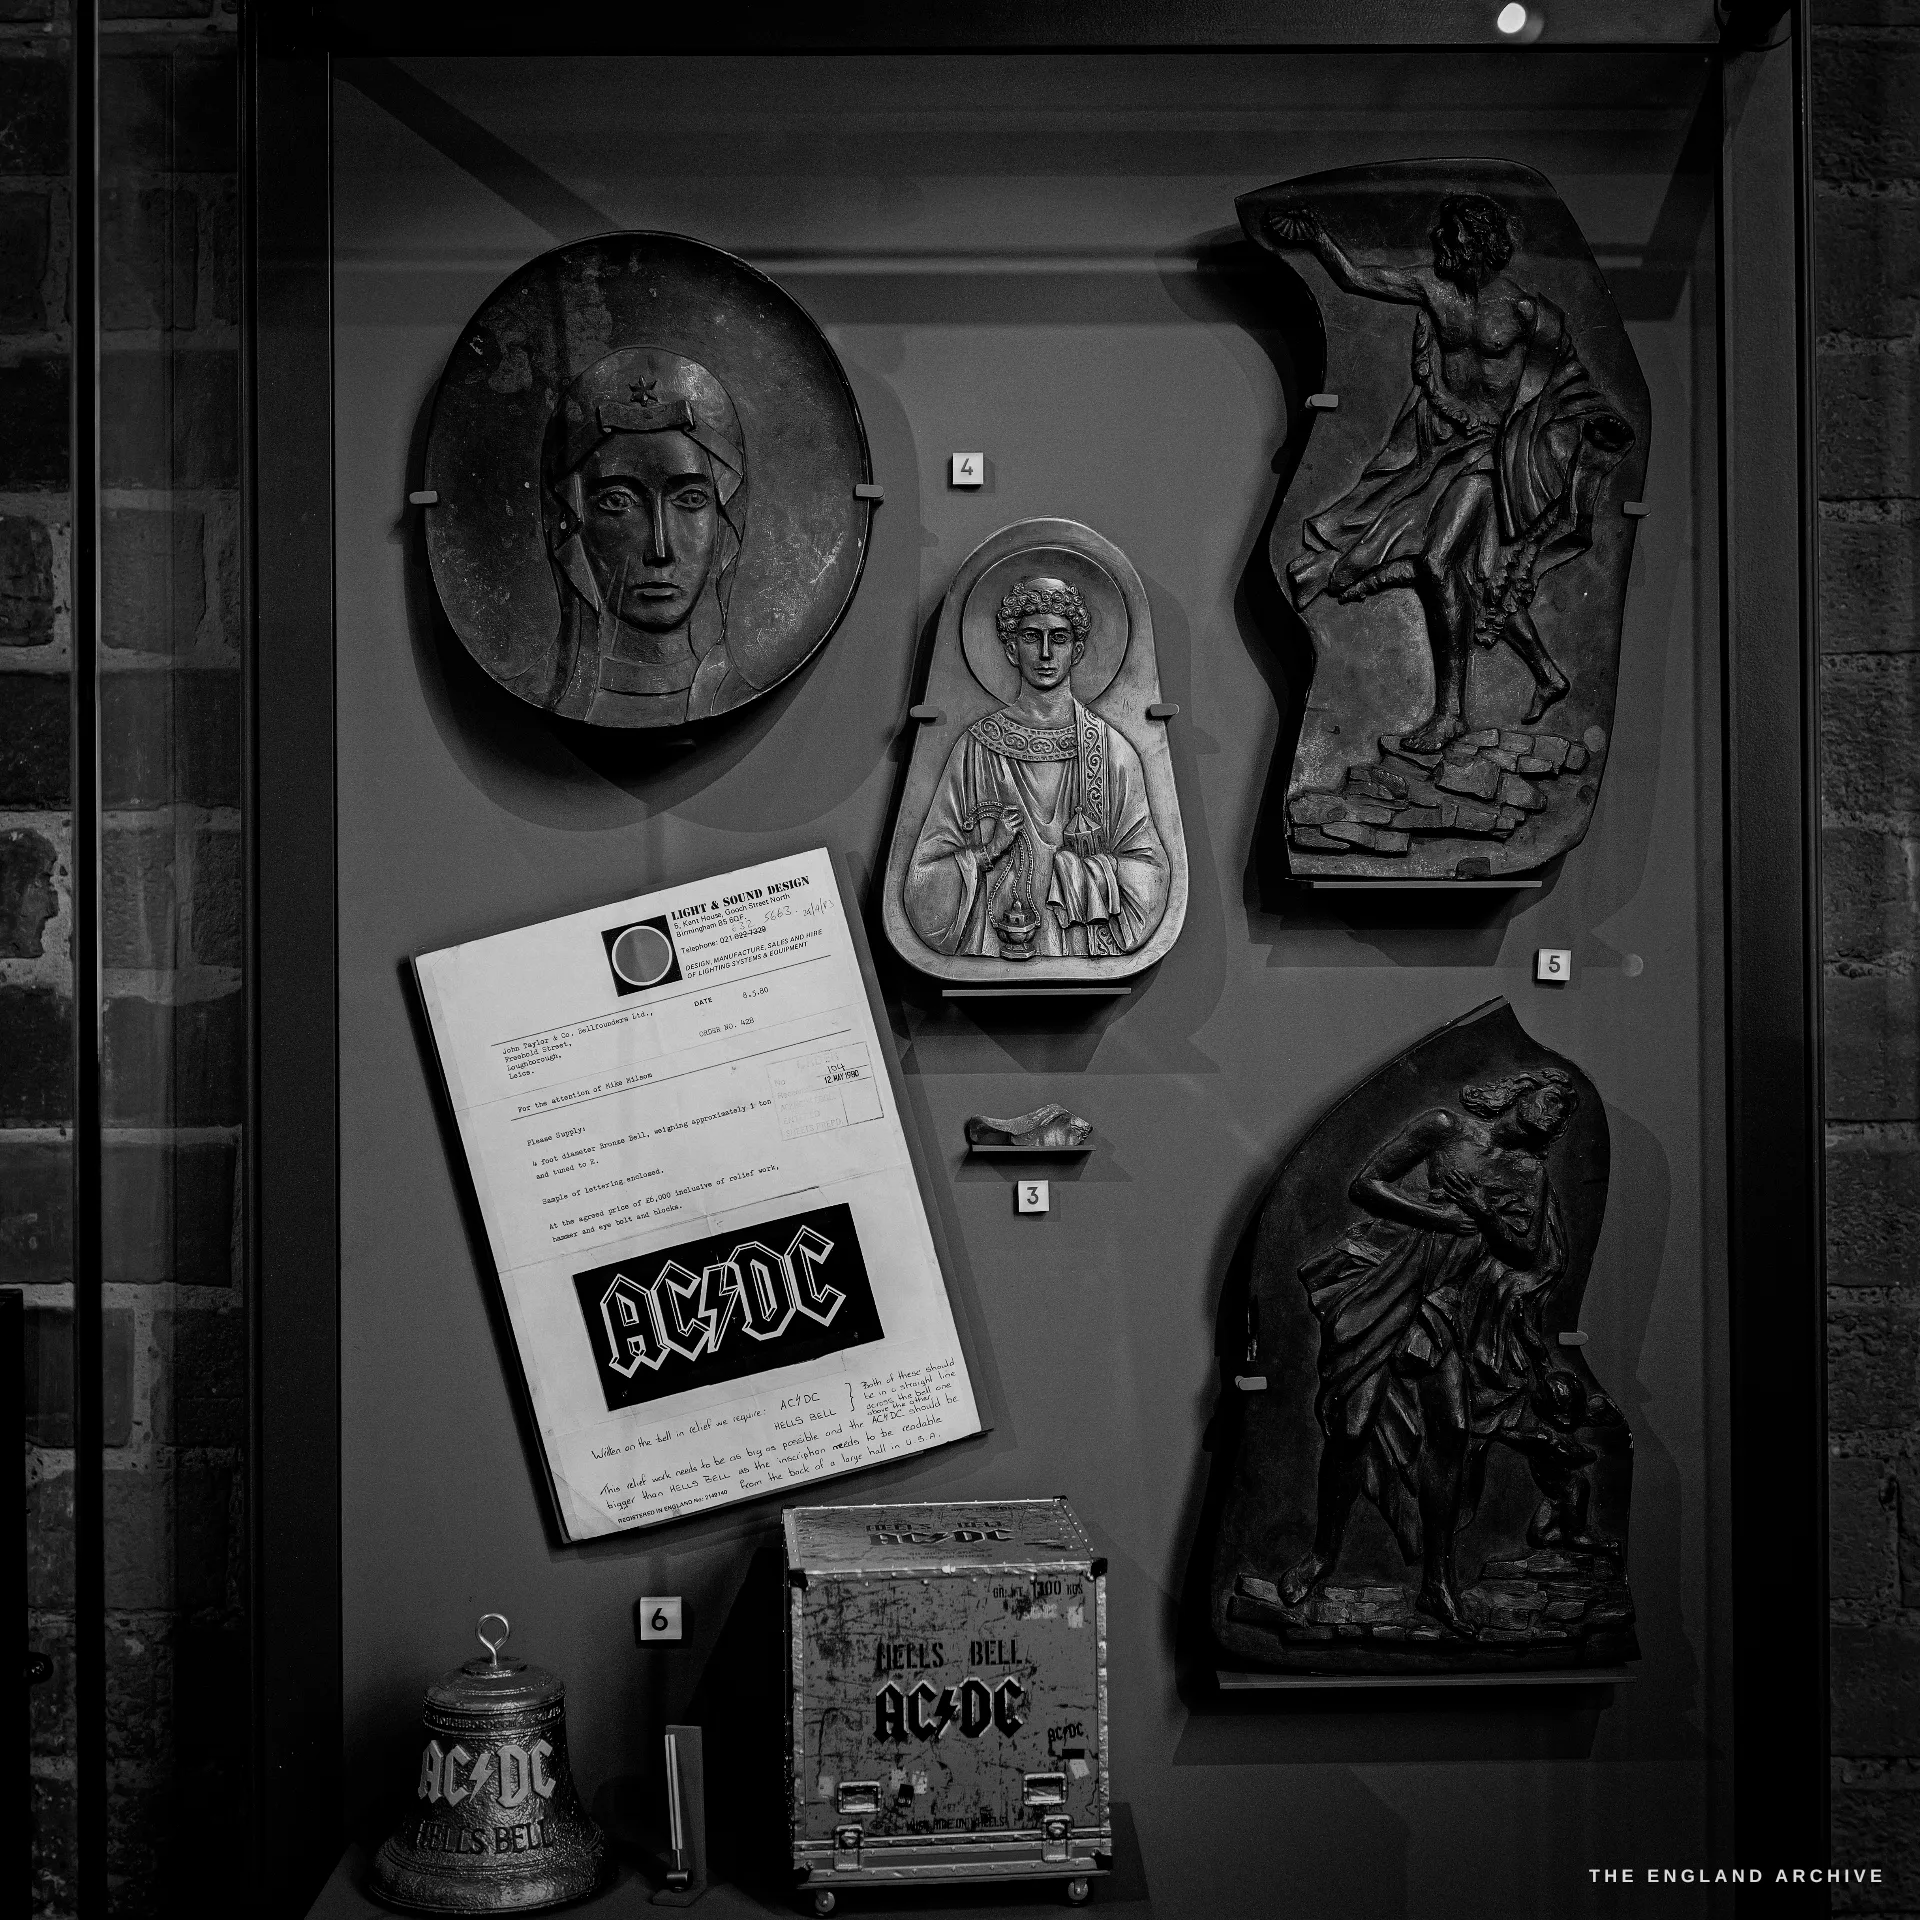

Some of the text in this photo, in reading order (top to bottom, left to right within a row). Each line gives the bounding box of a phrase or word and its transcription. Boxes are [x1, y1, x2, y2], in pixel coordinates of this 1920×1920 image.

[960, 458, 974, 476] 4
[671, 876, 809, 921] LIGHT & SOUND DESIGN
[683, 893, 790, 927] Kent House, Gooch Street North
[676, 923, 717, 937] Birmingham
[680, 941, 718, 954] Telephone:
[686, 929, 822, 971] DESIGN, MANUFACTURE, SALES AND HIRE
[699, 962, 730, 976] LIGHTING
[732, 954, 761, 966] SYSTEMS
[770, 941, 808, 956] EQUIPMENT
[1548, 956, 1560, 972] 5
[694, 997, 712, 1007] DATE
[523, 1039, 549, 1049] Taylor
[699, 1027, 721, 1037] ORDER
[505, 1041, 571, 1063] Freehold Street,
[552, 1090, 590, 1103] attention
[605, 1081, 622, 1089] Mike
[527, 1127, 585, 1146] Please Supply:
[541, 1156, 558, 1165] foot
[562, 1147, 595, 1159] diameter
[599, 1139, 625, 1149] Bronze
[628, 1132, 649, 1141] Bell,
[654, 1122, 688, 1134] weighing
[692, 1104, 746, 1125] approximately
[536, 1171, 549, 1179] and
[553, 1165, 574, 1175] tuned
[542, 1194, 568, 1204] Sample
[584, 1180, 624, 1193] lettering
[627, 1168, 663, 1182] enclosed.
[579, 1210, 604, 1222] agreed
[608, 1205, 629, 1215] price
[675, 1183, 712, 1196] inclusive
[729, 1170, 754, 1181] relief
[758, 1165, 779, 1173] work,
[1027, 1188, 1038, 1205] 3
[552, 1232, 578, 1242] hammer
[582, 1226, 595, 1234] and
[615, 1217, 632, 1225] bolt
[653, 1205, 682, 1215] blocks.
[860, 1357, 954, 1389] Both of these should
[900, 1374, 932, 1390] straight
[938, 1370, 956, 1379] line
[867, 1398, 894, 1409] across
[897, 1393, 912, 1401] the
[914, 1385, 931, 1396] bell
[774, 1409, 837, 1430] HELLS BELL
[867, 1407, 888, 1415] above
[591, 1445, 621, 1459] Written
[638, 1437, 652, 1447] the
[655, 1431, 671, 1443] bell
[689, 1418, 711, 1433] relief
[733, 1409, 765, 1423] require:
[600, 1483, 620, 1495] This
[627, 1474, 646, 1489] relief
[652, 1470, 671, 1482] work
[676, 1462, 697, 1476] needs
[701, 1459, 711, 1468] to
[713, 1456, 725, 1465] be
[746, 1448, 762, 1456] big
[783, 1431, 819, 1450] possible
[826, 1424, 842, 1436] and
[849, 1419, 864, 1429] the
[909, 1398, 940, 1414] should
[946, 1396, 959, 1404] be
[606, 1496, 635, 1511] bigger
[642, 1490, 663, 1500] than
[670, 1480, 698, 1492] HELLS
[703, 1473, 730, 1483] BELL
[754, 1460, 770, 1470] the
[833, 1436, 859, 1450] needs
[865, 1431, 875, 1441] to
[880, 1428, 894, 1437] be
[902, 1414, 943, 1431] readable
[740, 1479, 762, 1489] from
[768, 1472, 783, 1481] the
[788, 1463, 810, 1476] back
[815, 1458, 823, 1470] of
[841, 1453, 862, 1464] large
[867, 1444, 886, 1455] hall
[618, 1510, 657, 1524] REGISTERED
[664, 1500, 692, 1511] ENGLAND
[651, 1607, 669, 1631] 6
[876, 1639, 1023, 1670] HELLS BELL
[493, 1818, 556, 1854] BELL
